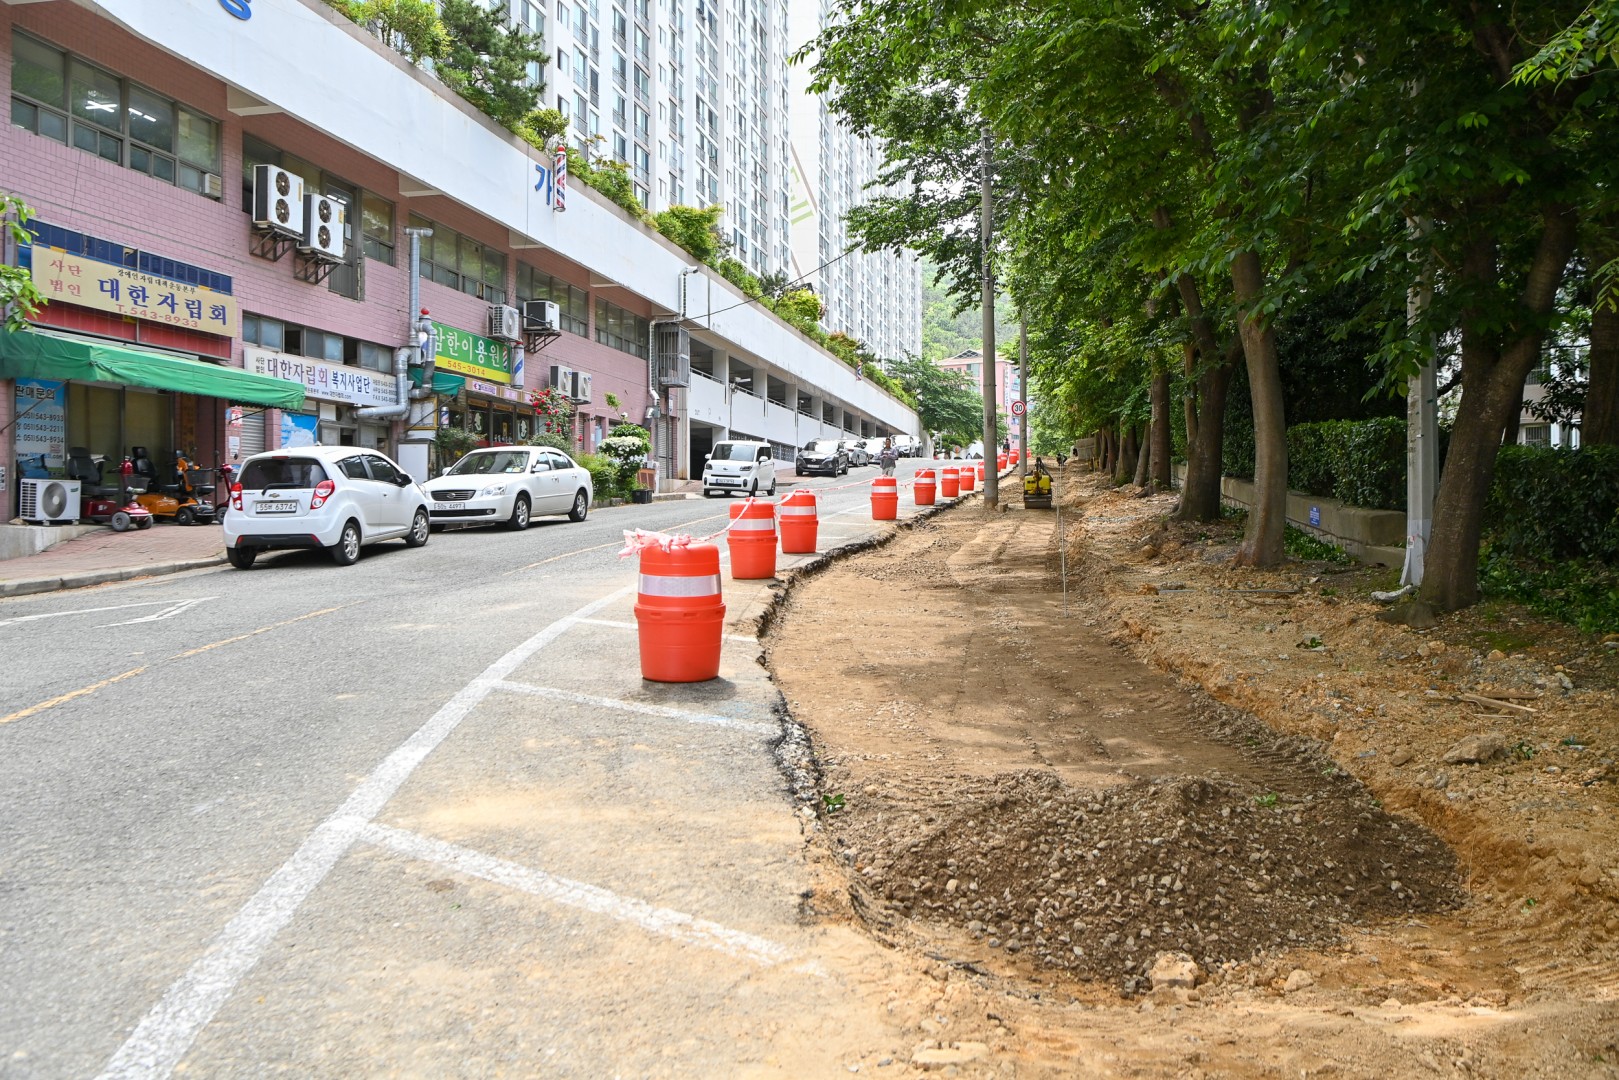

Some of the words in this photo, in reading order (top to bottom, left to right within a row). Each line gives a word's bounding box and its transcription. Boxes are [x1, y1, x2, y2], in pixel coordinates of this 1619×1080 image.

[49, 260, 82, 277] 사단
[49, 279, 82, 297] 법인
[98, 278, 227, 325] 대한자립회
[267, 357, 328, 387] 대한자립회
[331, 370, 371, 394] 복지사업단
[447, 360, 486, 376] 545-3014
[275, 503, 293, 511] 6374
